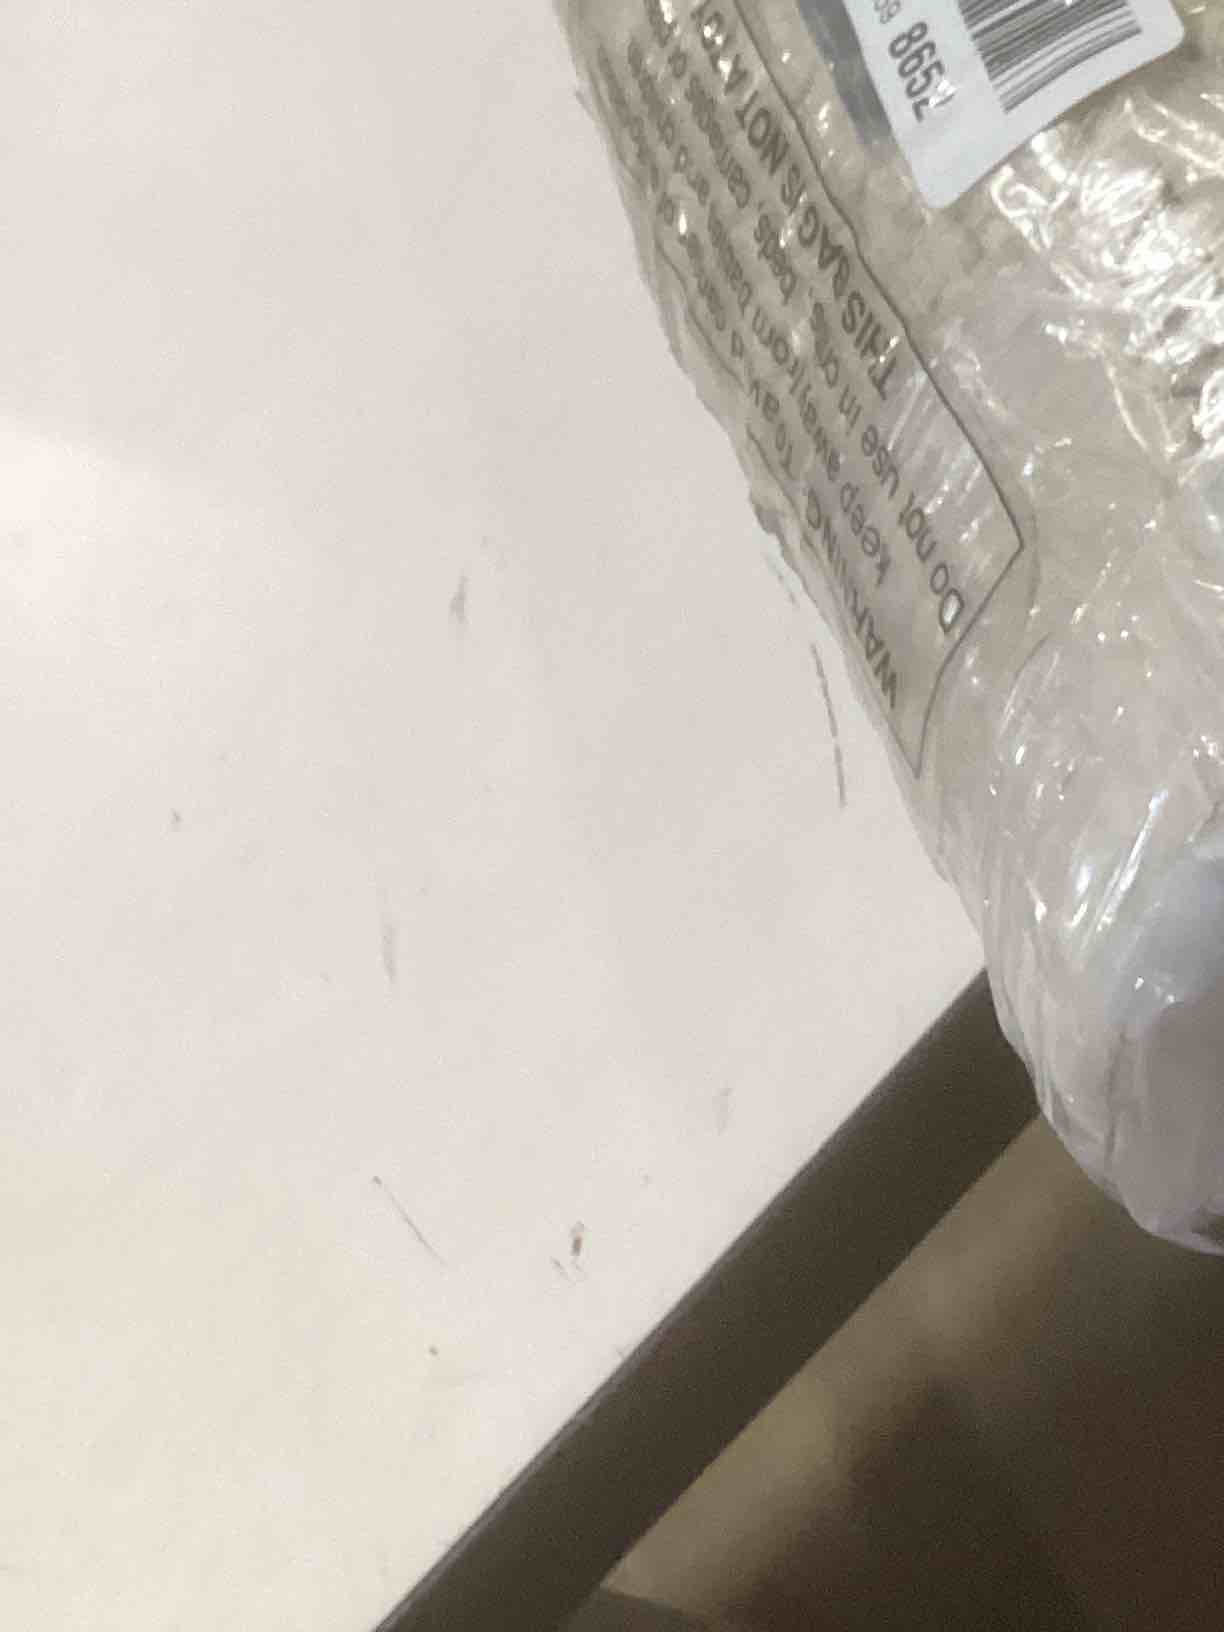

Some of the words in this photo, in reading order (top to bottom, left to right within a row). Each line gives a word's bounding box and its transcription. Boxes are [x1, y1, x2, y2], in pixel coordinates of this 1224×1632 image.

[717, 53, 750, 98] A
[734, 90, 790, 177] NOT
[780, 164, 809, 213] IS
[797, 204, 850, 302] BAG
[840, 290, 898, 401] THIS
[860, 423, 900, 499] use
[898, 493, 938, 564] not
[929, 561, 965, 634] Do
